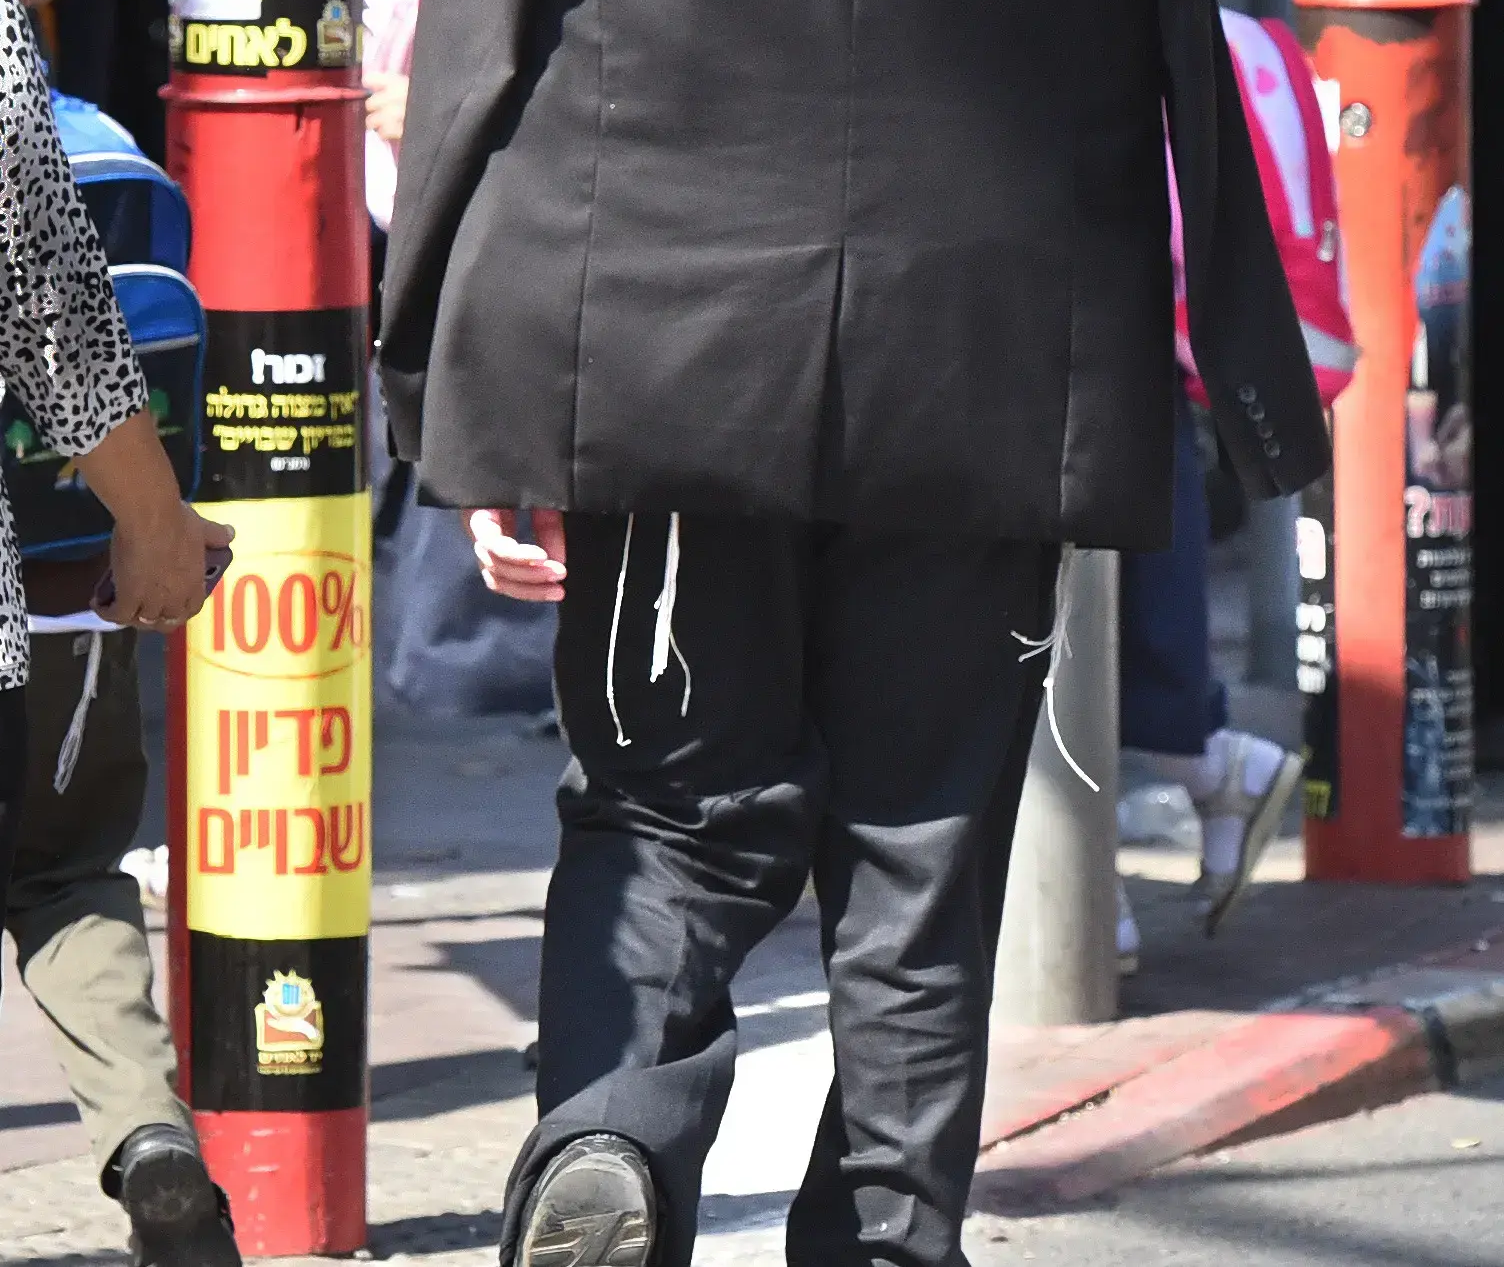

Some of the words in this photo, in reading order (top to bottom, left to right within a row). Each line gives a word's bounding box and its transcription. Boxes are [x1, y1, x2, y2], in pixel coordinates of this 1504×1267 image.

[186, 18, 307, 67] לאחים
[209, 570, 365, 654] 100%
[217, 705, 354, 796] פדיון
[198, 802, 365, 876] שבויים
